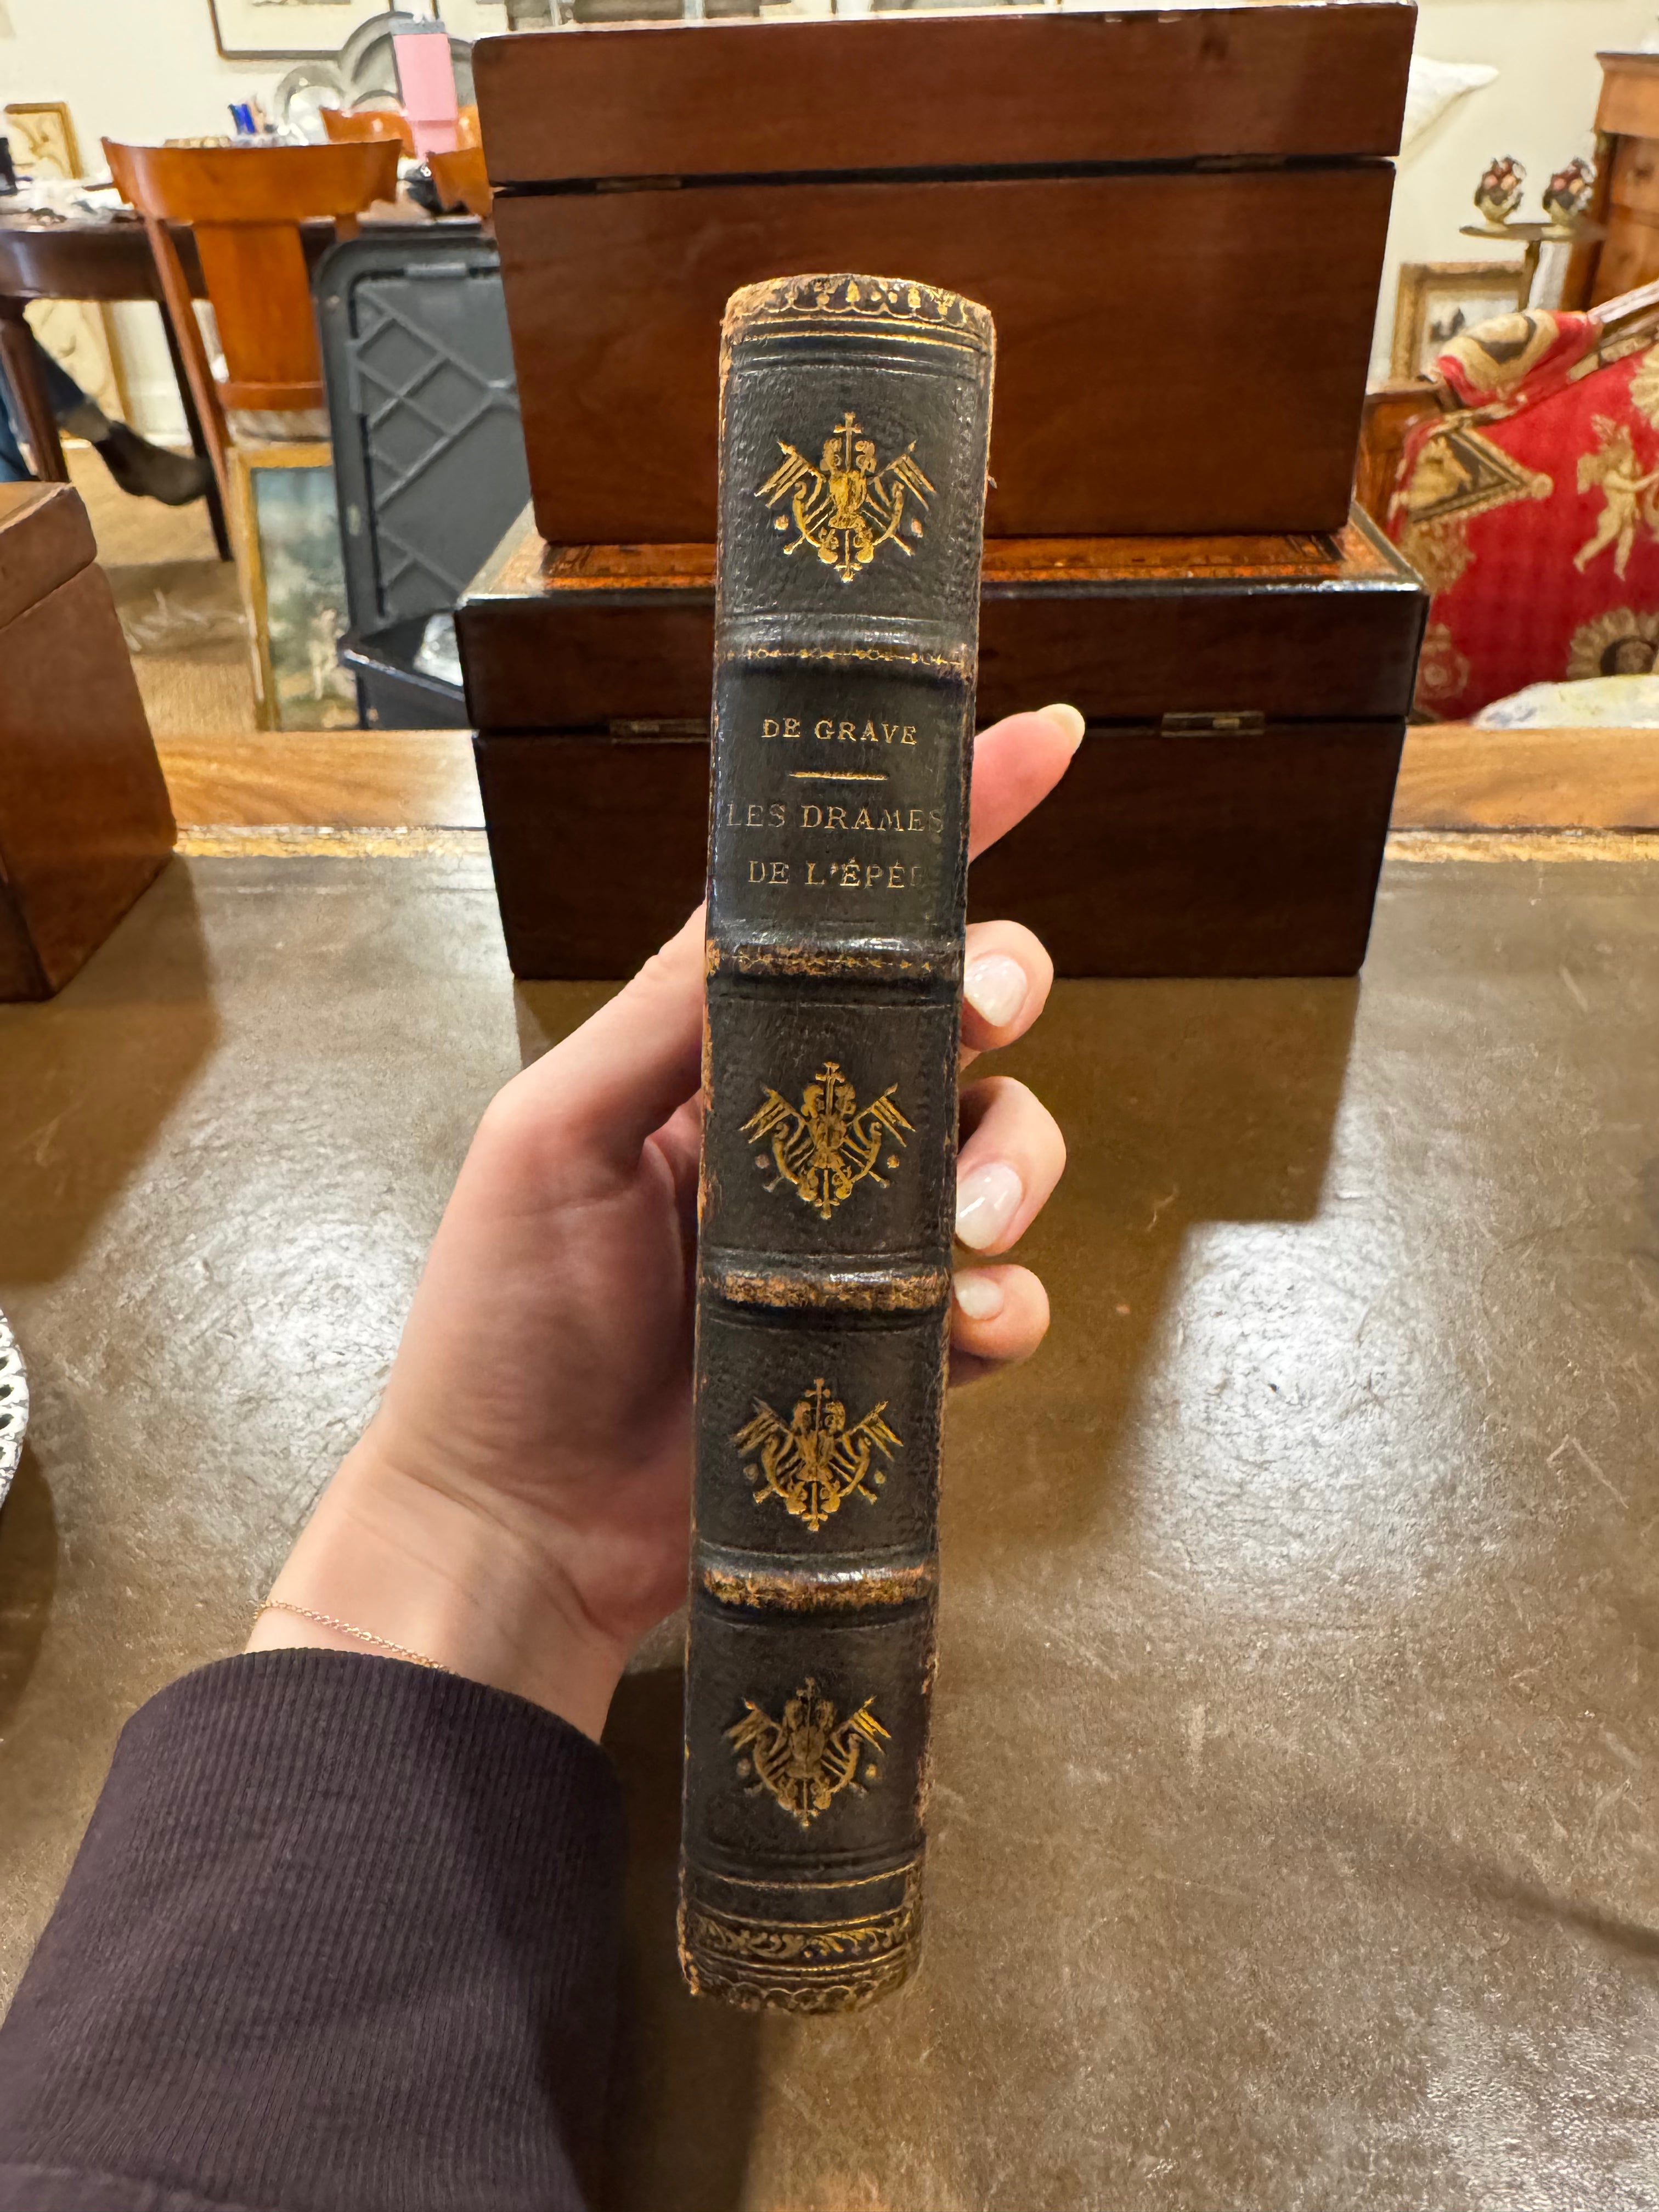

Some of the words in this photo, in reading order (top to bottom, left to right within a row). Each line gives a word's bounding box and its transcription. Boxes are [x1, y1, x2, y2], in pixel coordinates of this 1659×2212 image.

[761, 718, 800, 738] DE
[814, 719, 917, 745] GRAVE
[726, 801, 786, 828] LES
[799, 804, 944, 833] DRAMES
[748, 860, 789, 884] DE
